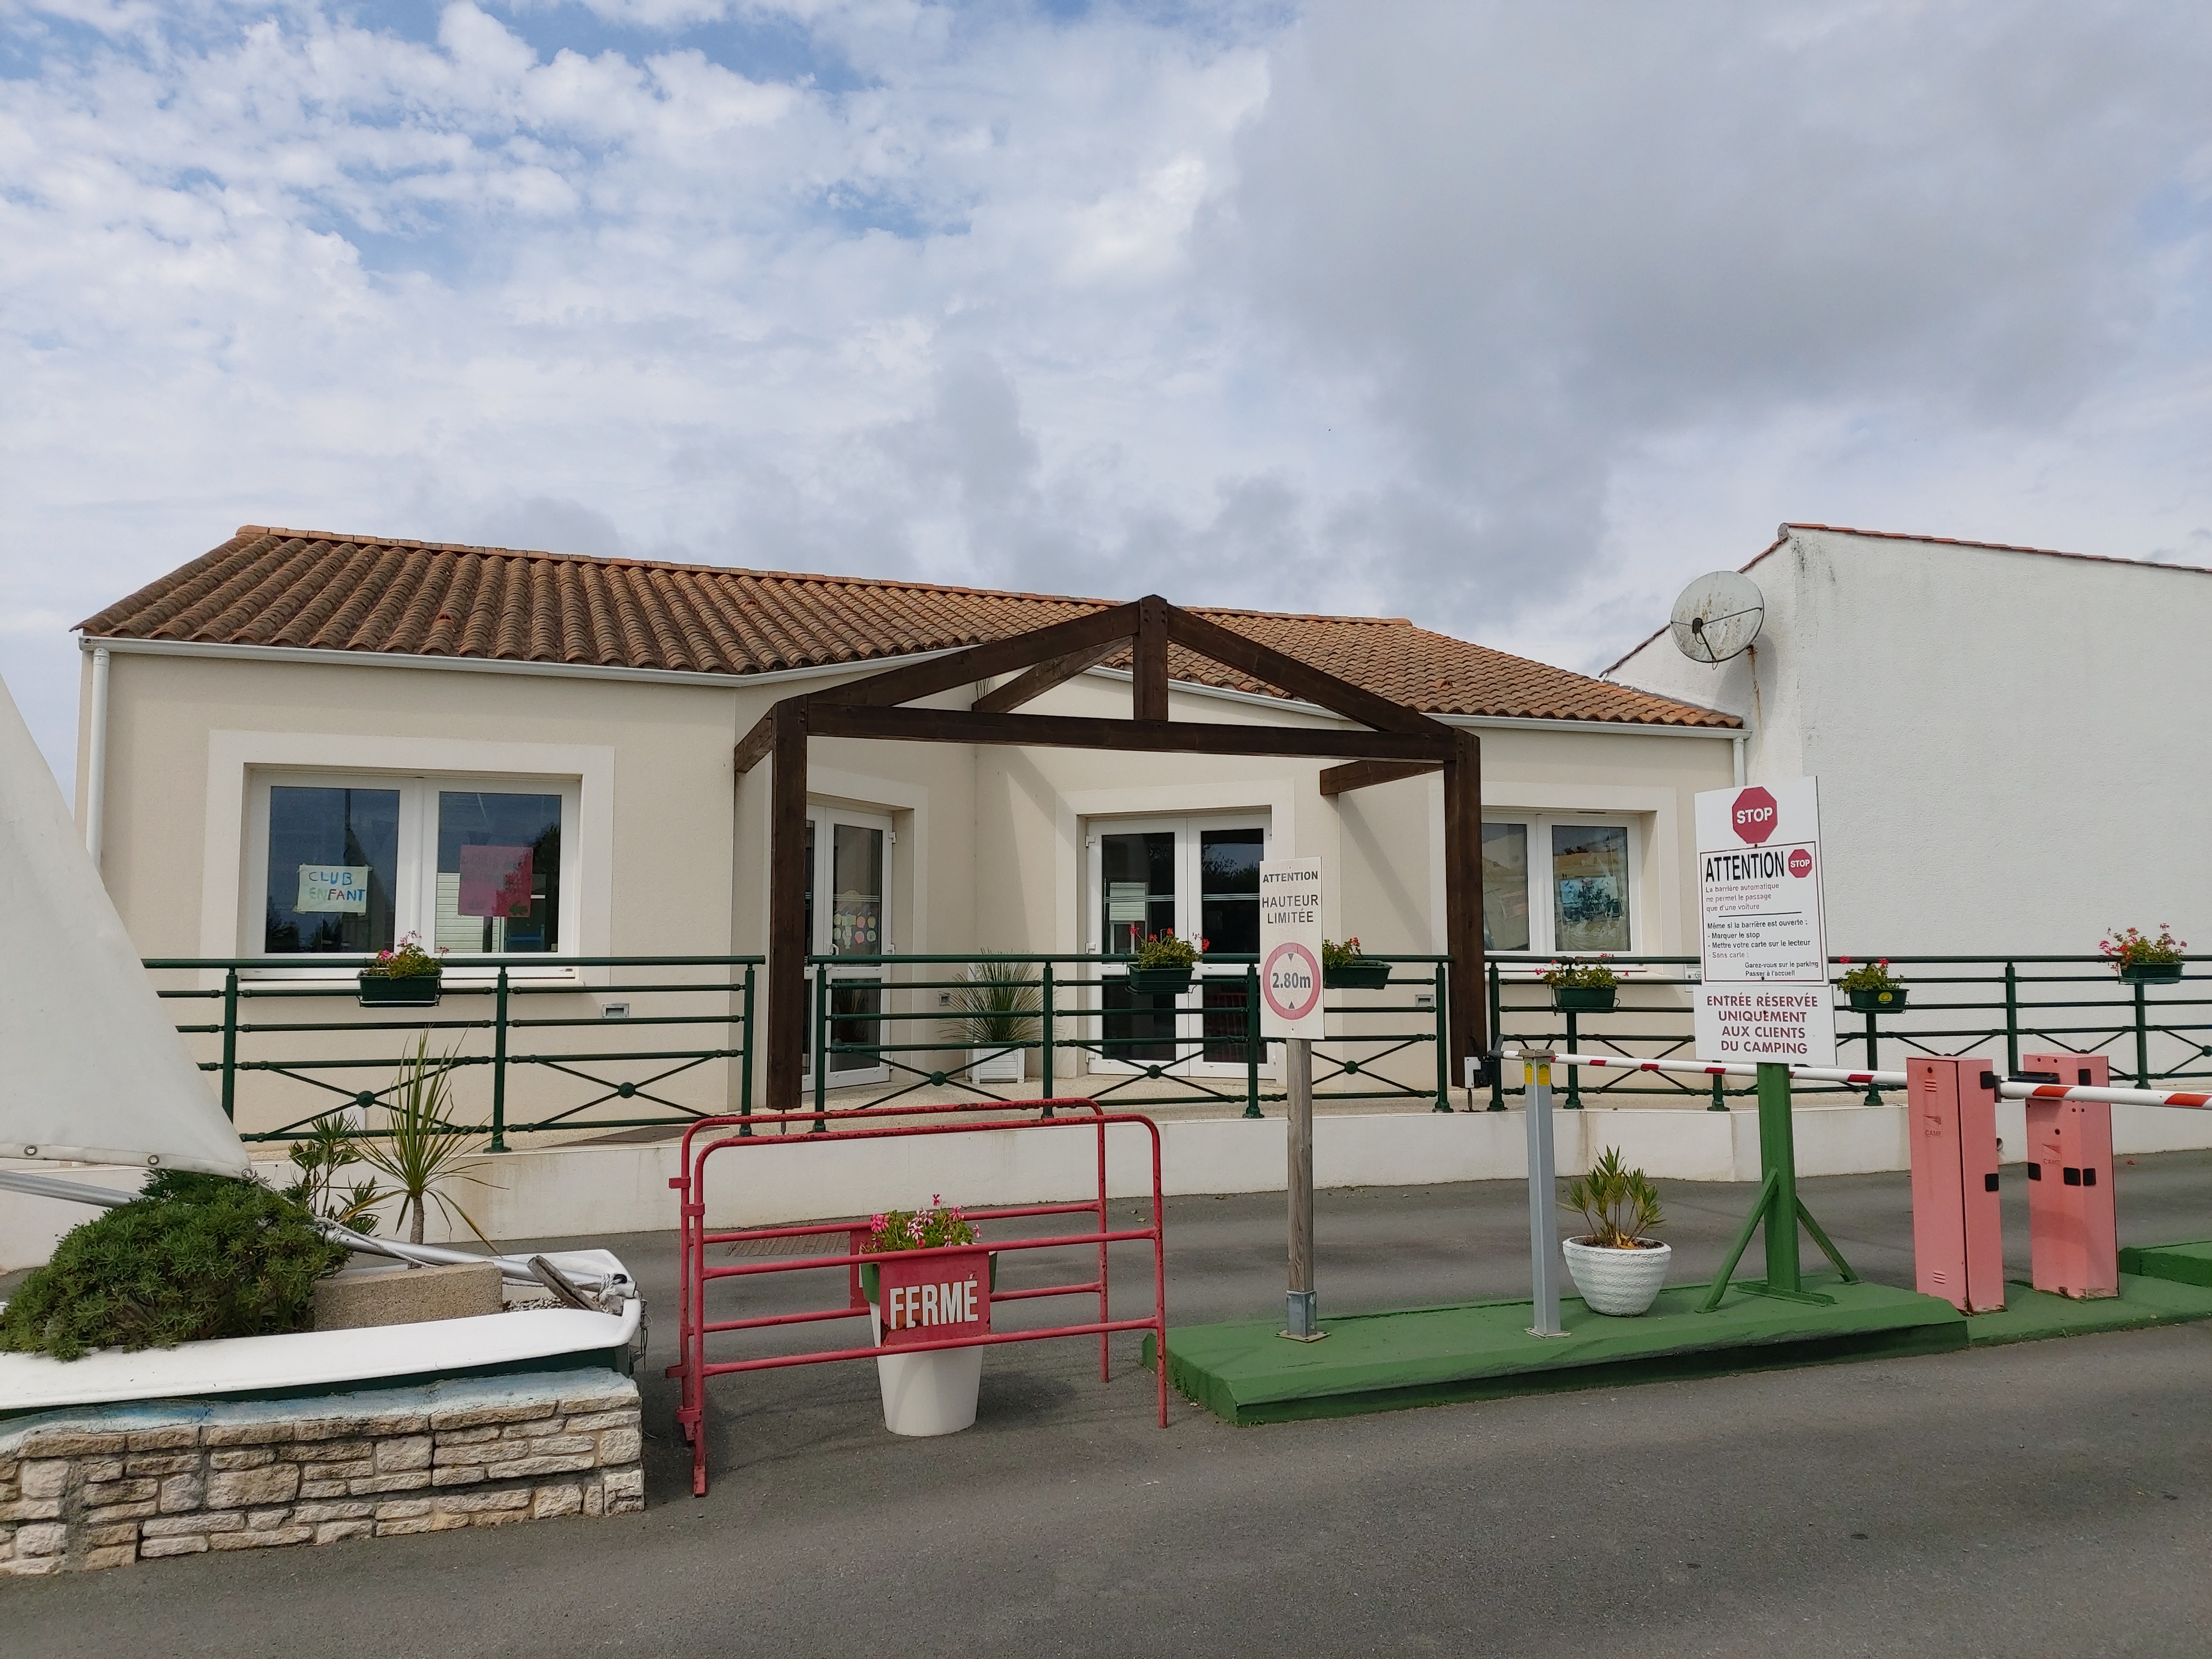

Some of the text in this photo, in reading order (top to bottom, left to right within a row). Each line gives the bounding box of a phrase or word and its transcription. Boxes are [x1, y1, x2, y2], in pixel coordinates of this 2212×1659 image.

[1736, 807, 1773, 824] STOP
[1705, 851, 1785, 882] ATTENTION
[1790, 859, 1810, 868] STOP
[309, 871, 352, 885] CLUB
[1262, 871, 1318, 883] ATTENTION
[309, 887, 366, 901] ENFANT
[1740, 883, 1780, 891] automatique
[1262, 894, 1319, 909] HAUTEUR
[1715, 894, 1737, 904] permet
[1745, 893, 1772, 903] passage
[1267, 909, 1314, 924] LIMITÉE
[1746, 932, 1760, 940] stop
[1796, 961, 1819, 969] parking
[1272, 972, 1311, 989] 2.80m
[1707, 992, 1818, 1007] ENTRÉE RÉSERVÉE
[1718, 1011, 1807, 1023] UNIQUEMENT
[1722, 1026, 1805, 1039] AUX CLIENTS
[1721, 1040, 1808, 1054] DU CAMPING
[890, 1273, 979, 1330] FERMÉ
